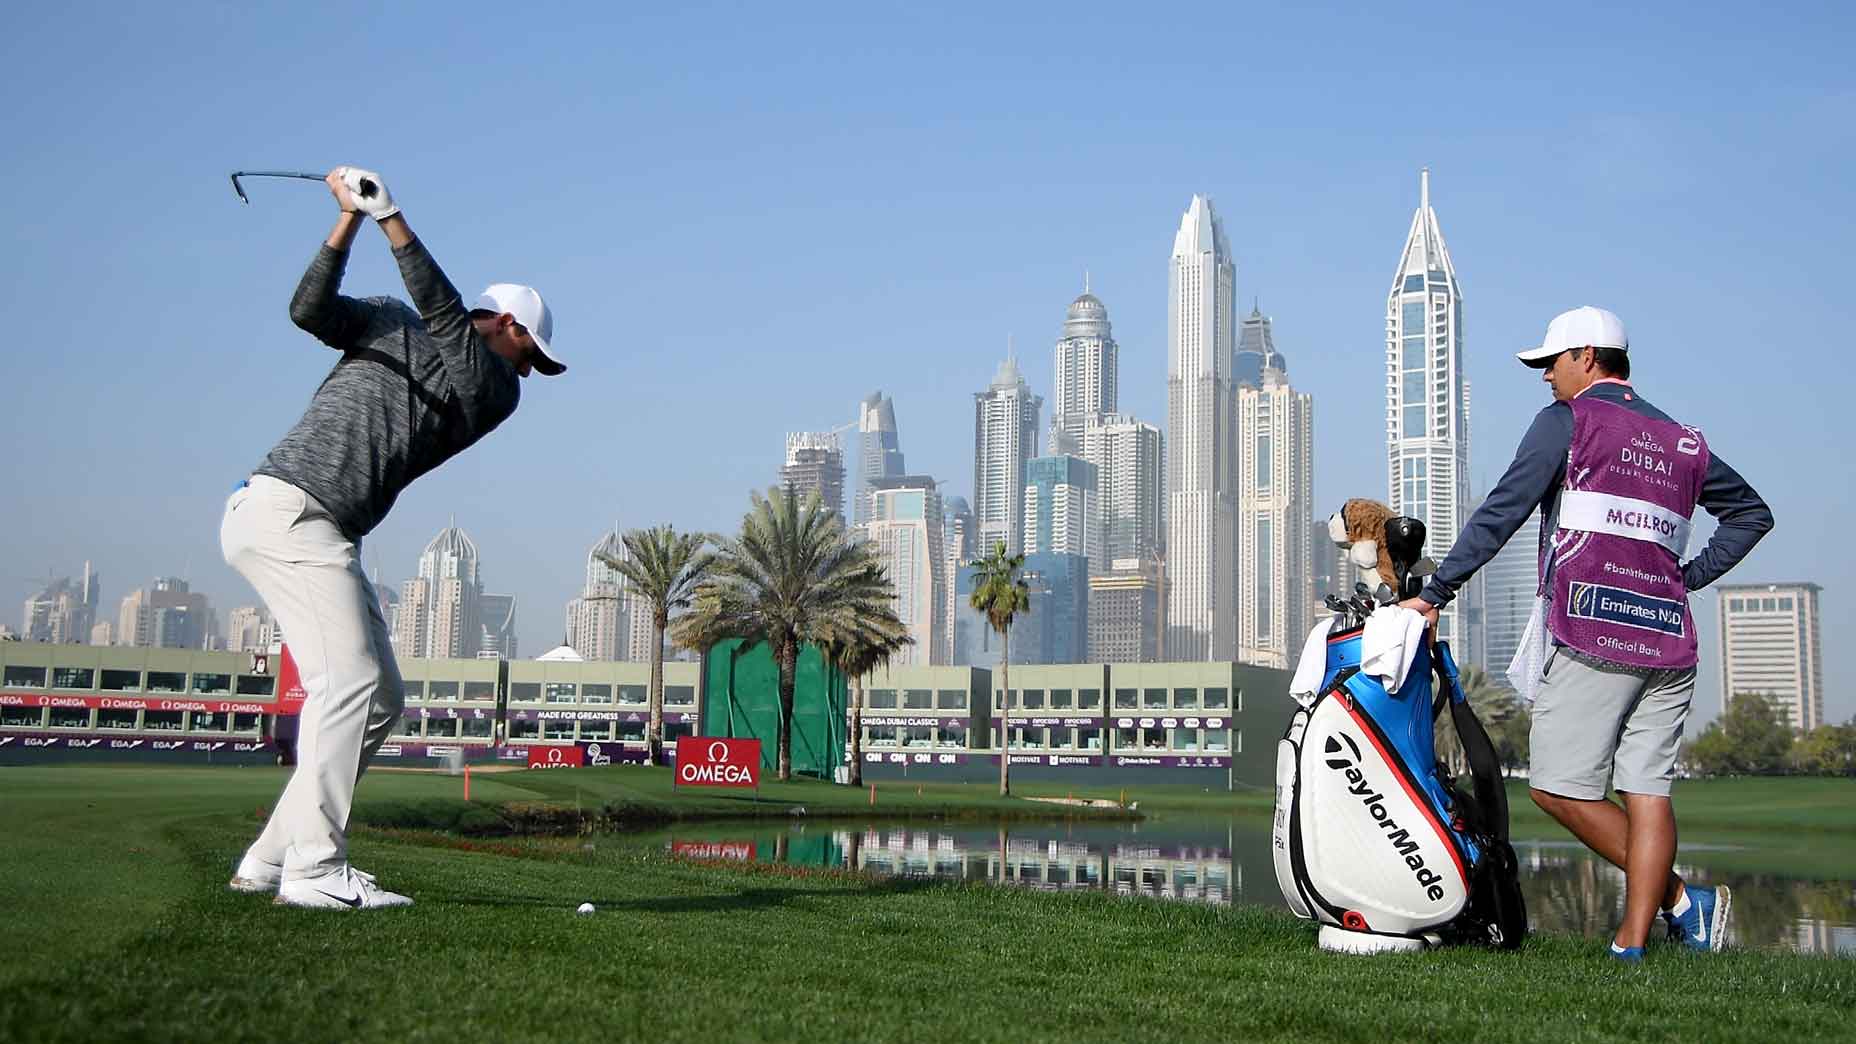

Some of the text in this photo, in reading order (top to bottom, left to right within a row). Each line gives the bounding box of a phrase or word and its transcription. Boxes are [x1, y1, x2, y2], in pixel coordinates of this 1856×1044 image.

[1631, 438, 1664, 454] OMEGA
[1621, 447, 1673, 477] DUBAI
[1610, 464, 1679, 491] DESERT CLASSIC
[1606, 508, 1678, 538] MCILROY
[1600, 597, 1656, 620] Emirates
[1596, 636, 1662, 657] Official Bank
[51, 698, 86, 706] OMEGA
[112, 699, 147, 708] OMEGA
[173, 701, 206, 710] OMEGA
[231, 704, 264, 712] OMEGA
[537, 711, 559, 719] MADE
[561, 712, 576, 720] FOR
[577, 712, 618, 720] GREATNESS
[861, 718, 886, 726] OMEGA
[887, 718, 907, 726] DUBAI
[68, 739, 87, 747] EGA
[111, 740, 129, 748] EGA
[153, 741, 171, 749] EGA
[194, 742, 211, 750] EGA
[234, 743, 252, 751] EGA
[682, 764, 752, 782] OMEGA
[1325, 731, 1445, 901] TaylorMade
